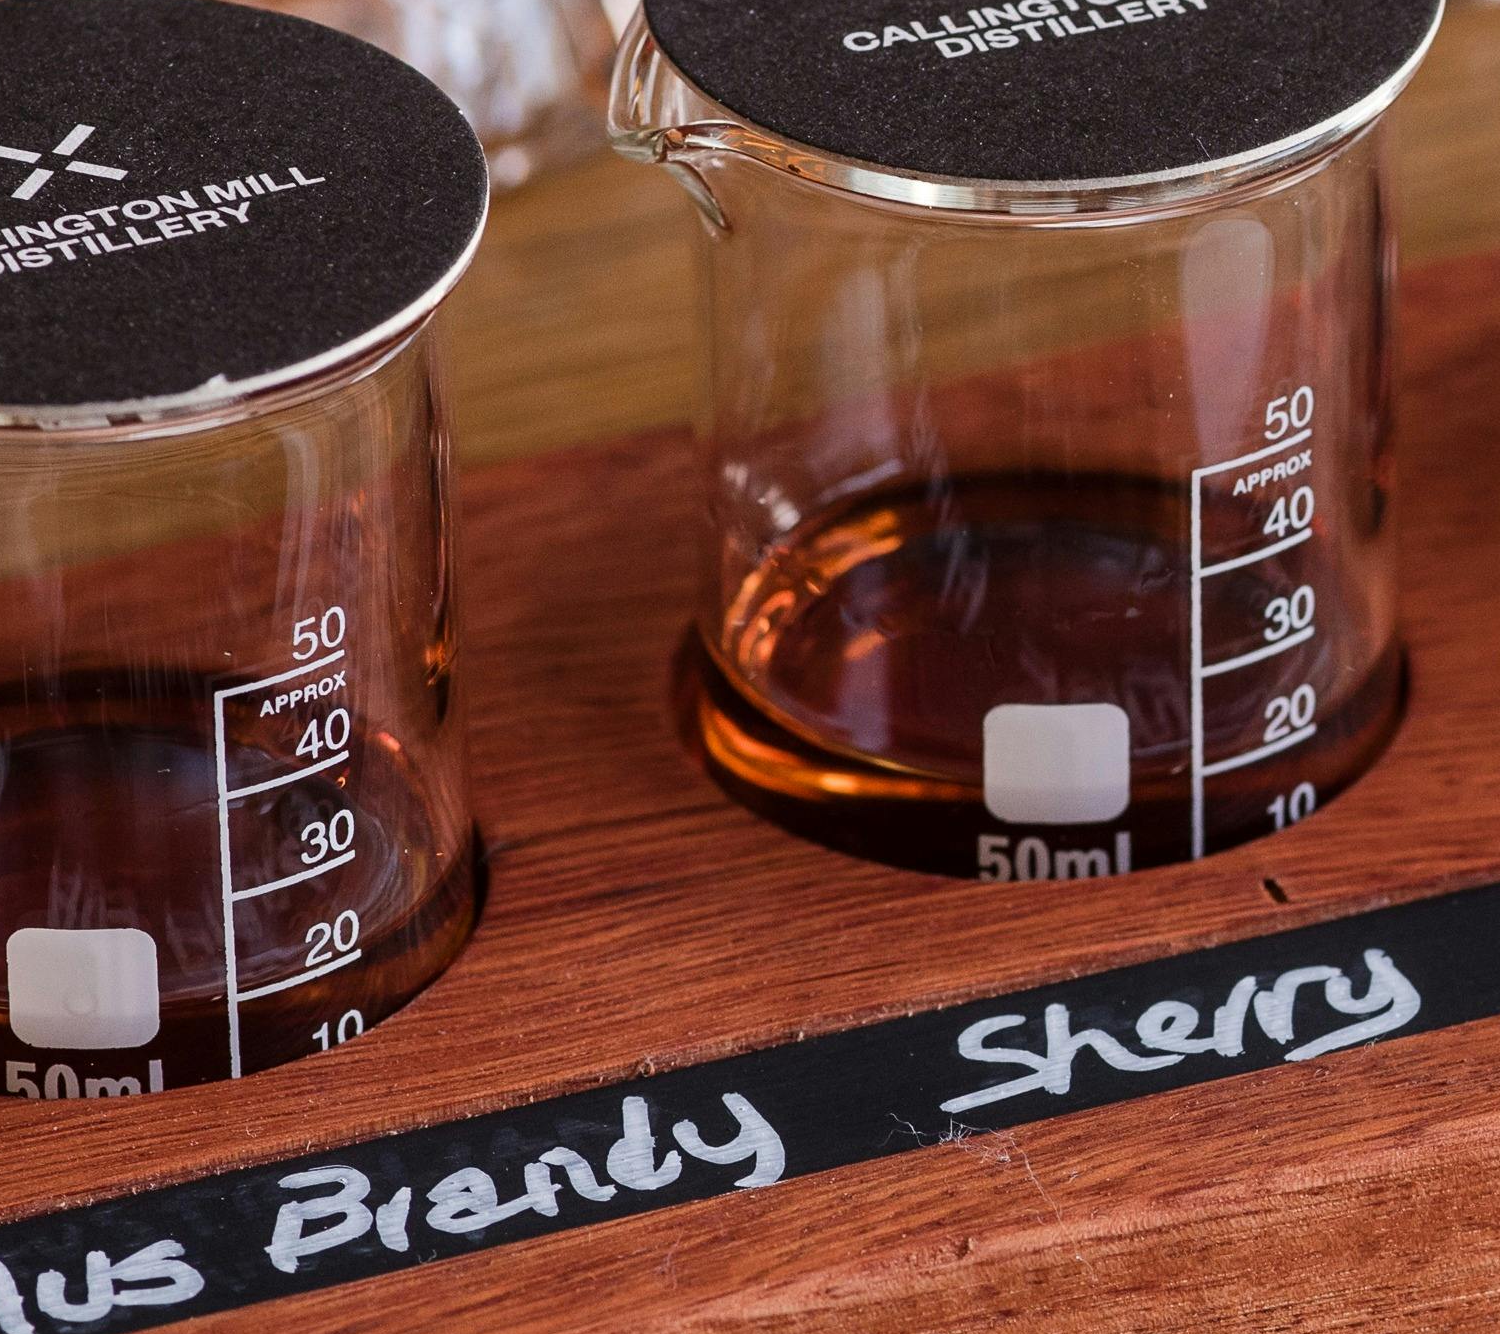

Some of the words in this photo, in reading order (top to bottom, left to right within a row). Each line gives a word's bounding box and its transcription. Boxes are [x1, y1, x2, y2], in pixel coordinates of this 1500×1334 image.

[203, 167, 326, 205] MILL
[1264, 386, 1313, 440] 50
[1233, 450, 1312, 496] APPROX
[1264, 486, 1314, 538] 40
[293, 606, 346, 660] 50
[1264, 585, 1314, 641] 30
[259, 671, 346, 717] APPROX
[1264, 685, 1315, 743] 20
[295, 708, 350, 760] 40
[1267, 783, 1315, 831] 10
[301, 809, 355, 865] 30
[977, 832, 1131, 882] 50ml
[304, 910, 359, 968] 20
[312, 1009, 363, 1051] 10
[266, 1092, 788, 1272] Brandy
[939, 947, 1423, 1116] Sherry
